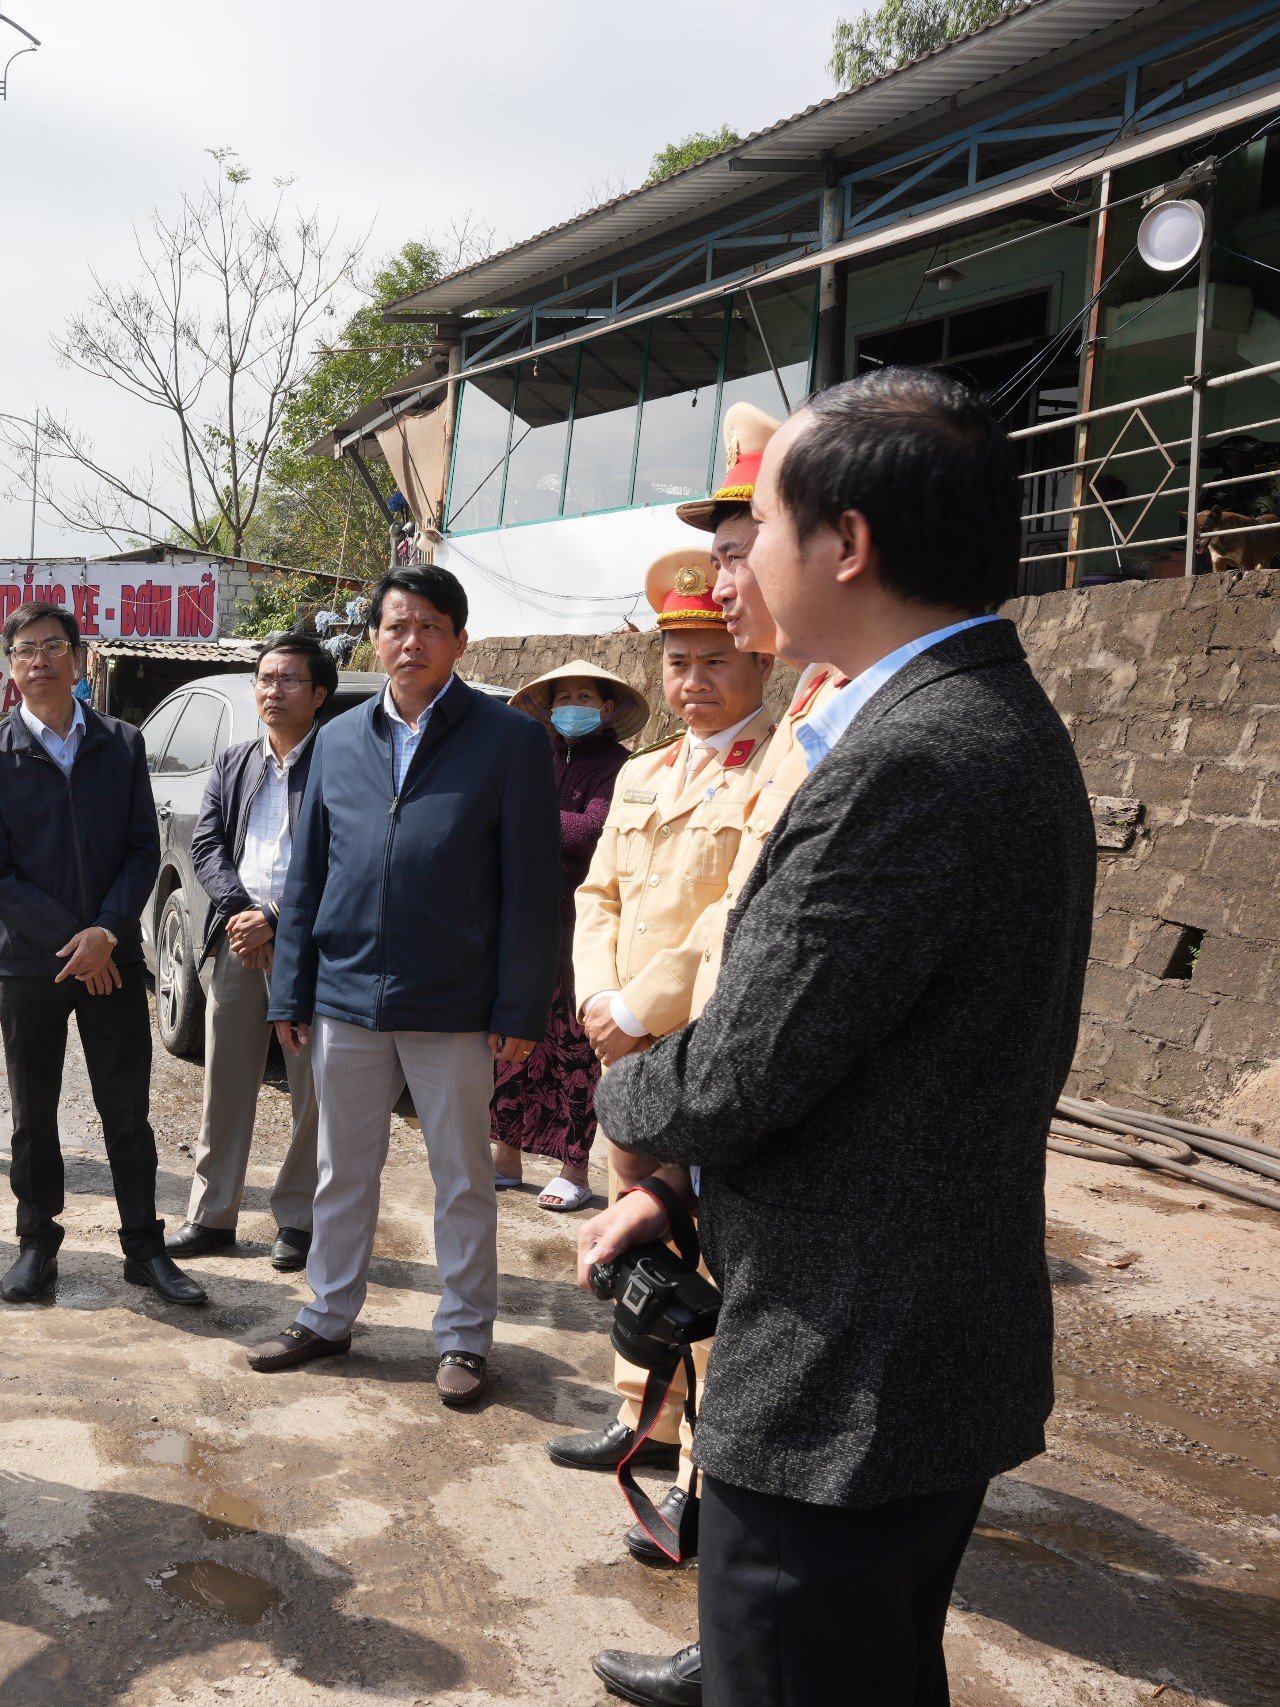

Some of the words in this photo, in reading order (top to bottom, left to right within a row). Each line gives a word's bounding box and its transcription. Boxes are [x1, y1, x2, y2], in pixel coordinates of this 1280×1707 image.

[71, 584, 100, 635] XE
[120, 579, 172, 637] BƠM
[177, 572, 216, 638] MỠ
